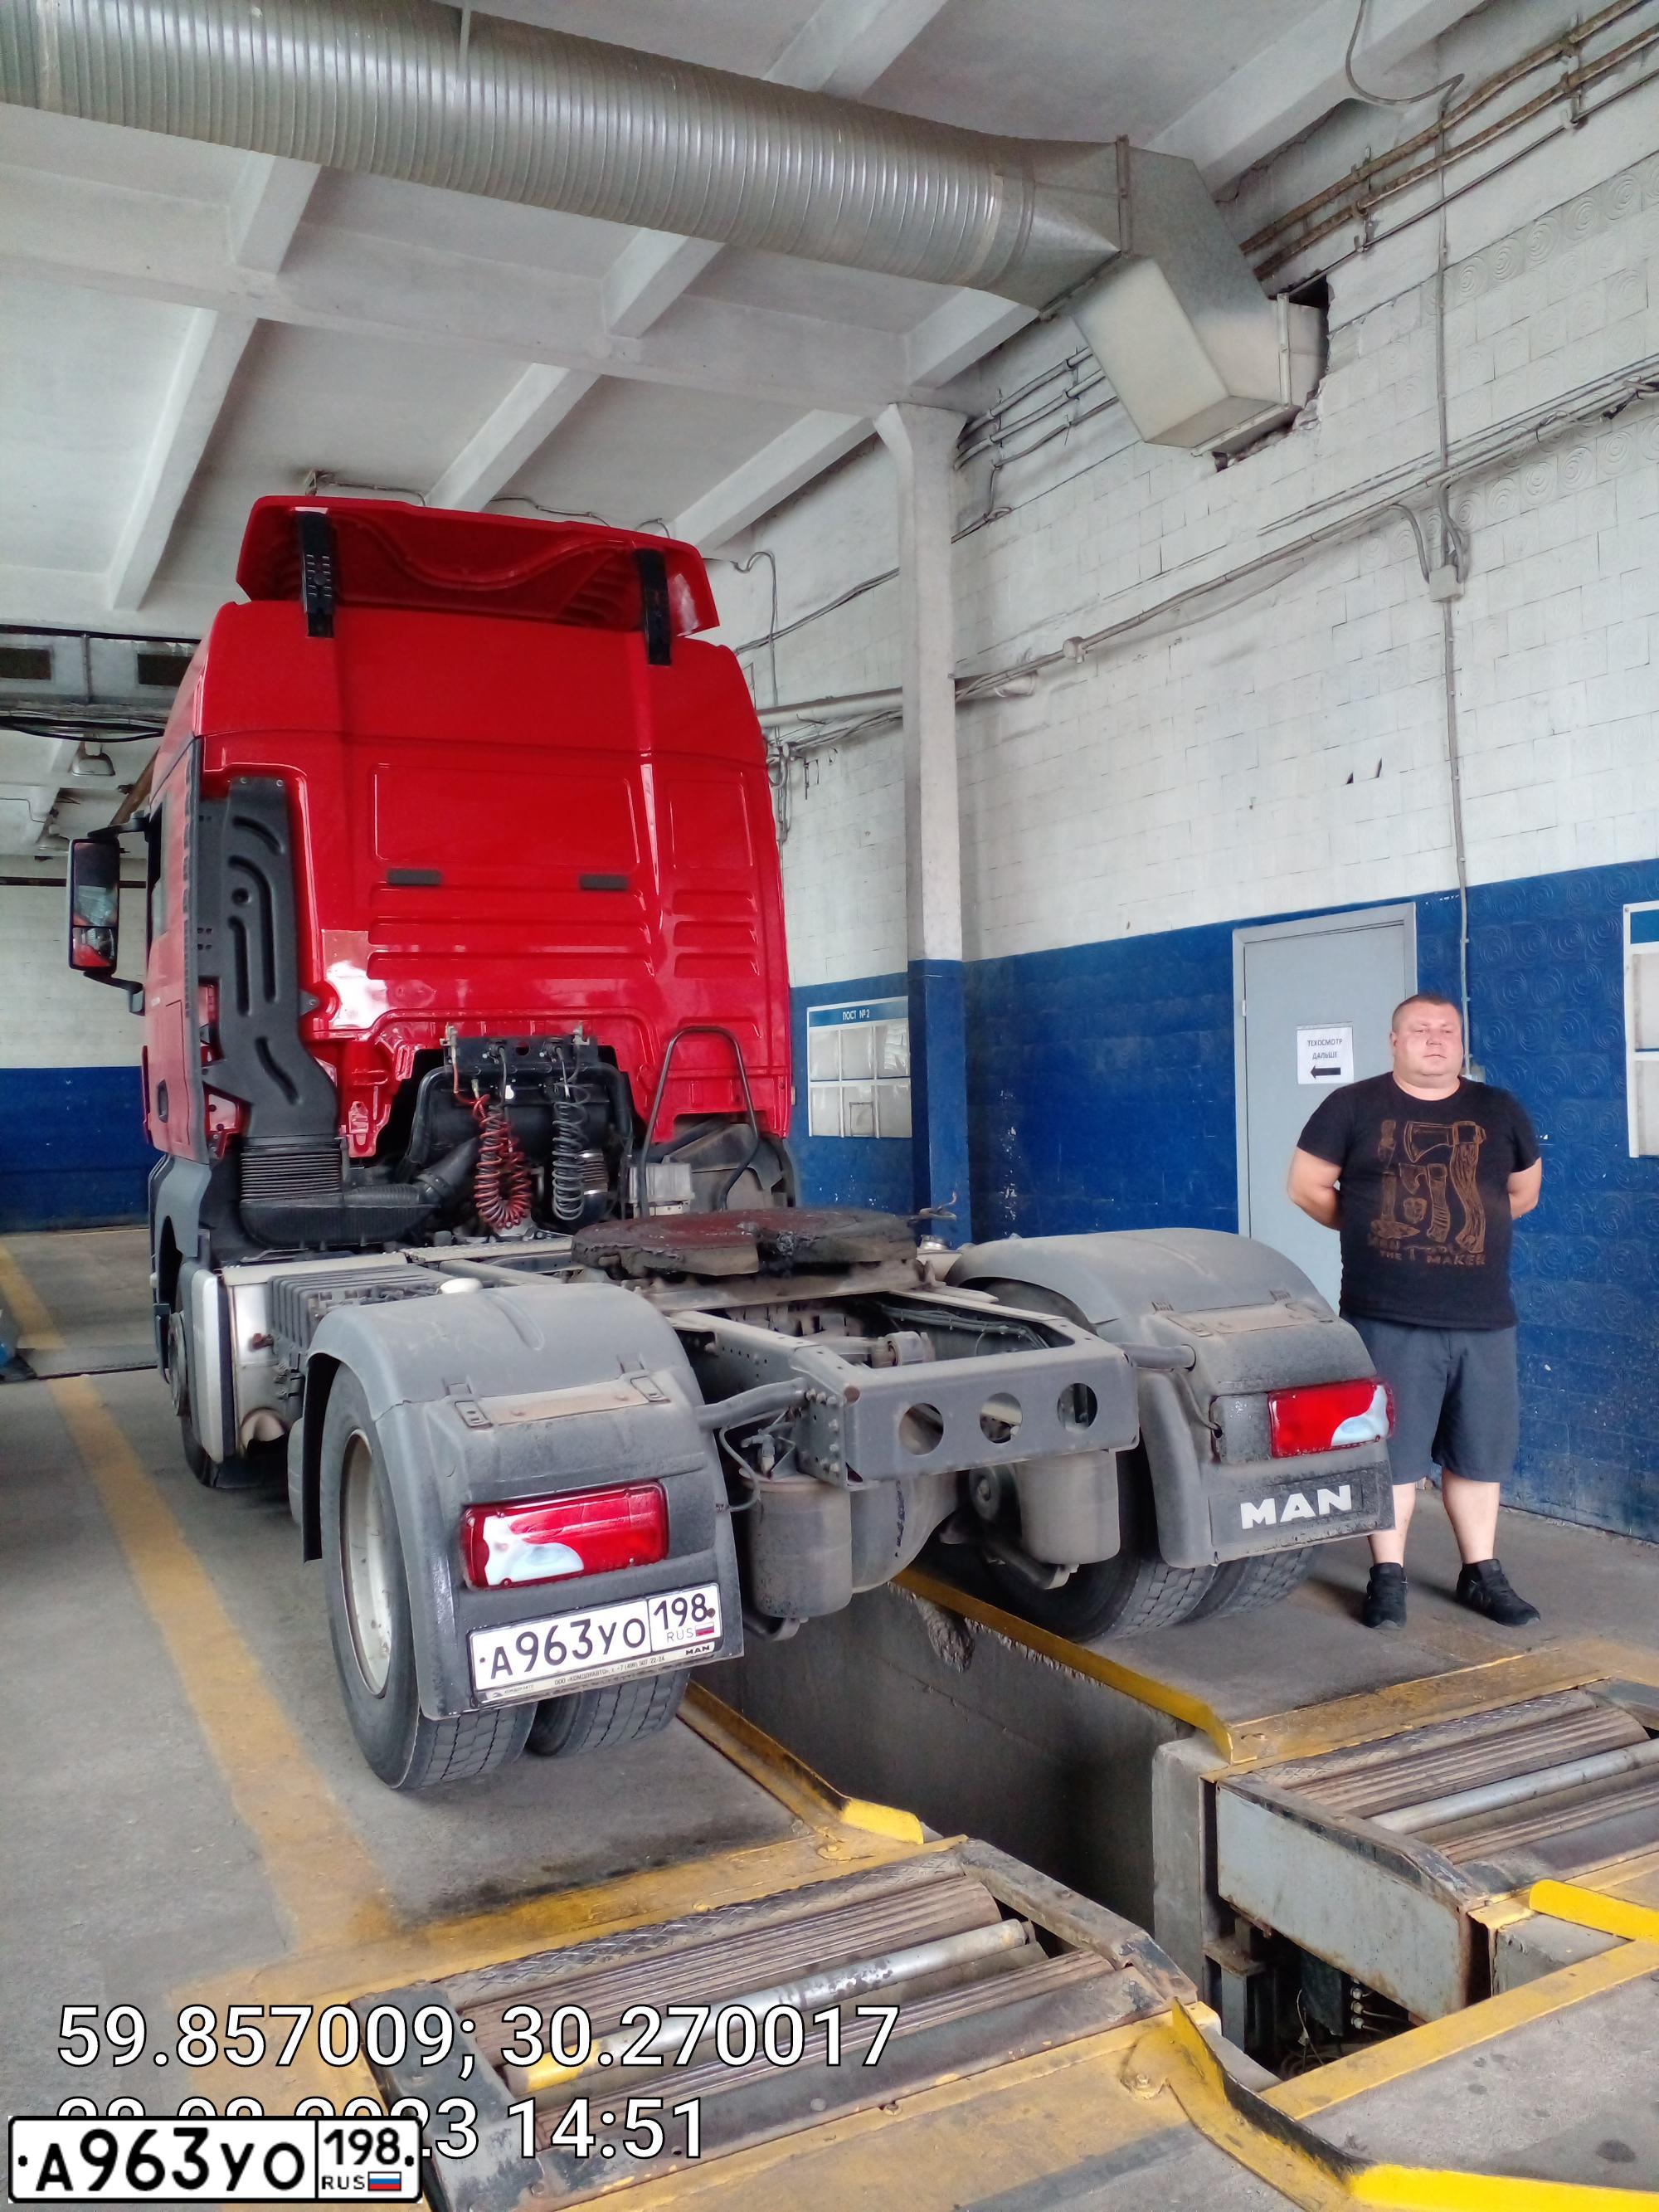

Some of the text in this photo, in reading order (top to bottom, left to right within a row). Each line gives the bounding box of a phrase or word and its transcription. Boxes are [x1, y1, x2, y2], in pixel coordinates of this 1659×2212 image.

[842, 1010, 857, 1021] ПОСТ
[1307, 1038, 1343, 1047] ТЕХОСМОТР
[1312, 1051, 1337, 1060] ДАЛЬШЕ
[1240, 1484, 1352, 1530] MAN
[653, 1592, 707, 1630] 198
[667, 1628, 694, 1643] RUS
[686, 1645, 710, 1655] MAN
